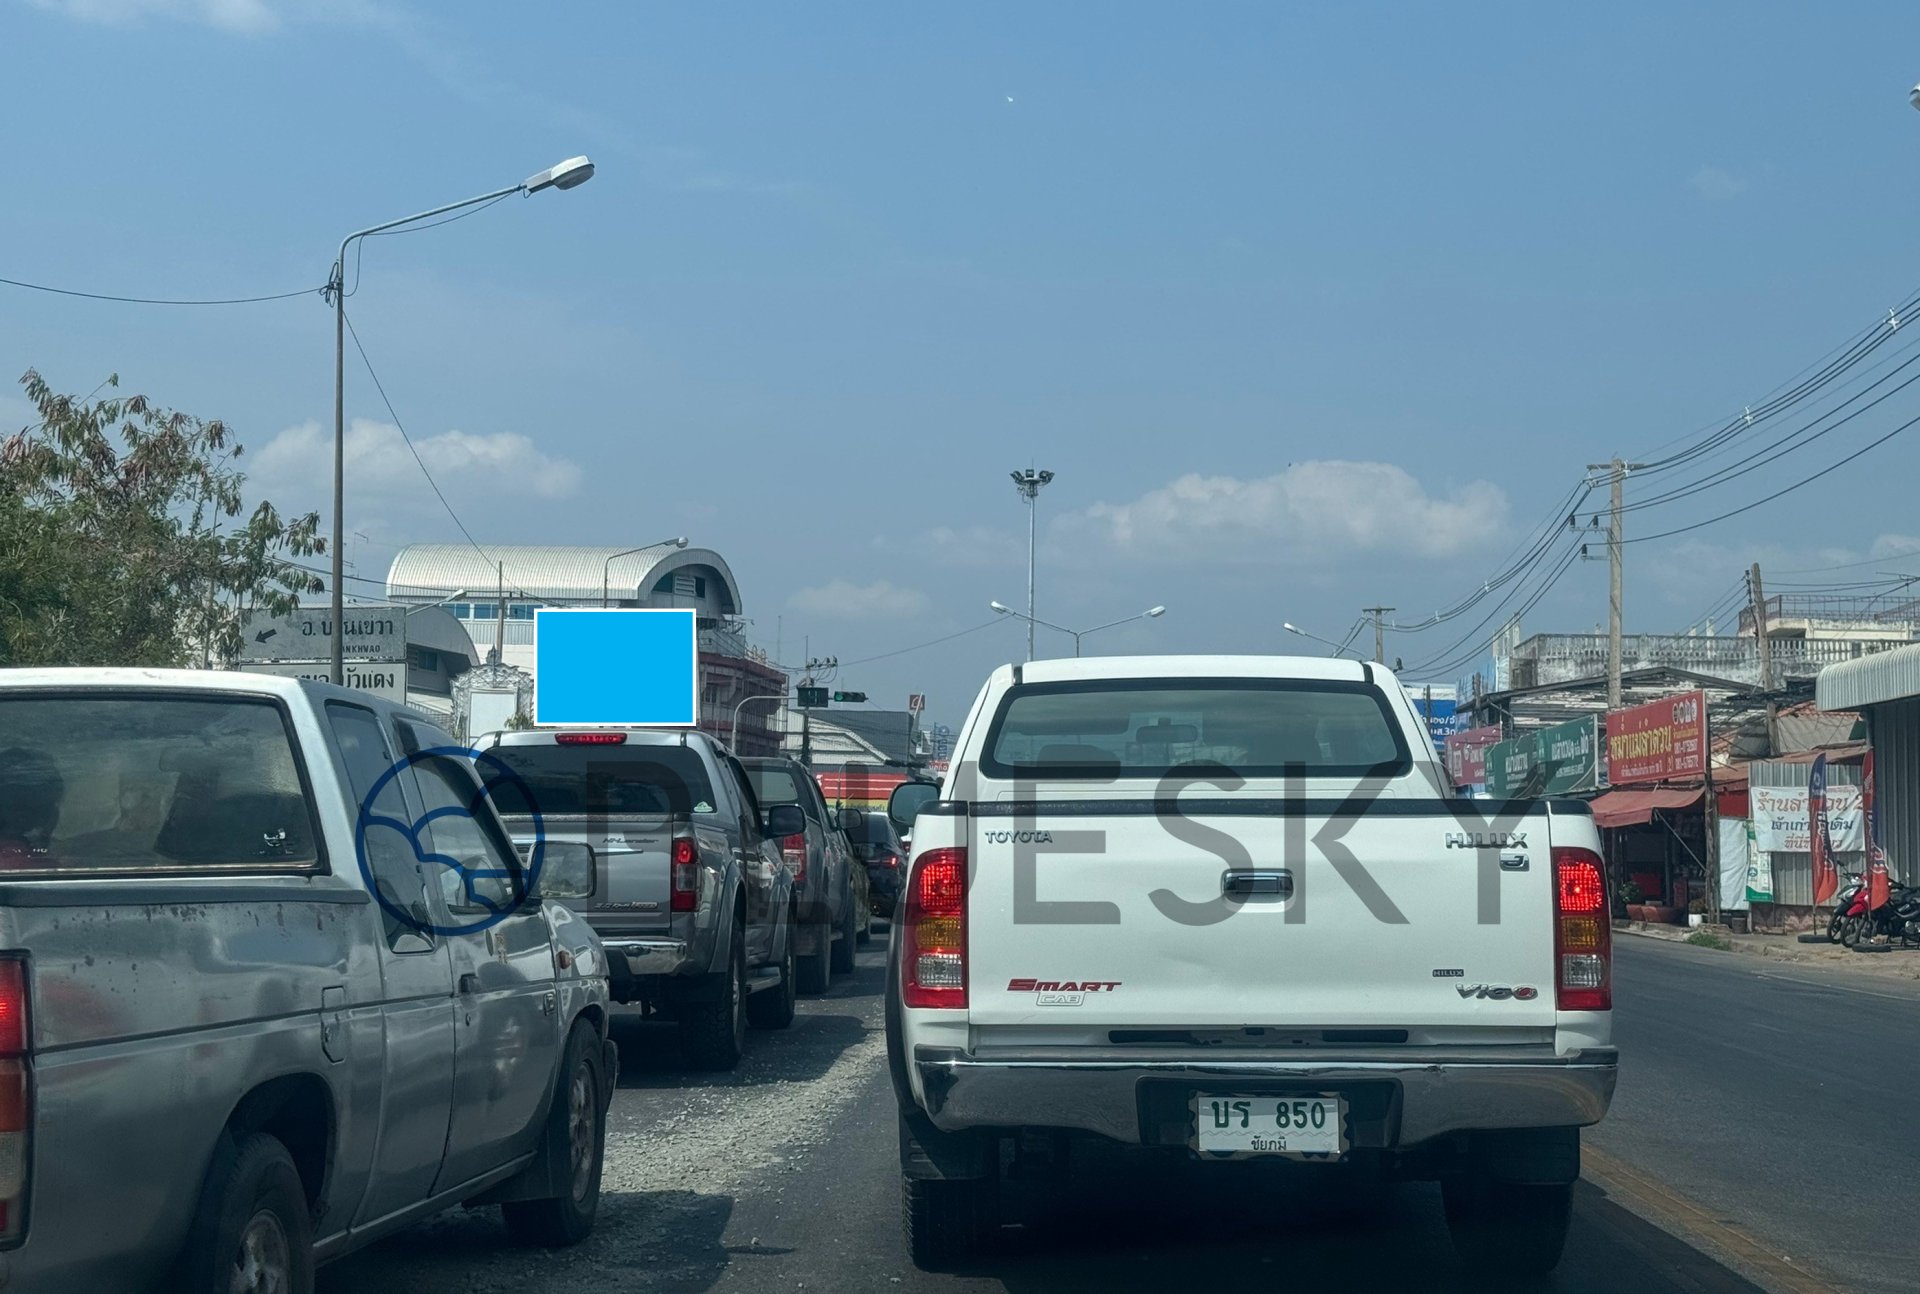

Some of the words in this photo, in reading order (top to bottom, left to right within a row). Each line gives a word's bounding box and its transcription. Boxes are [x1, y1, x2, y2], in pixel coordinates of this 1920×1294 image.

[302, 621, 316, 636] อ.
[1758, 791, 1849, 811] ร้านลำวน
[985, 830, 1053, 844] TOYOTA
[1445, 832, 1528, 849] HILUX
[1039, 995, 1081, 1004] CAB
[1211, 1101, 1250, 1128] บร
[1276, 1101, 1326, 1129] 850
